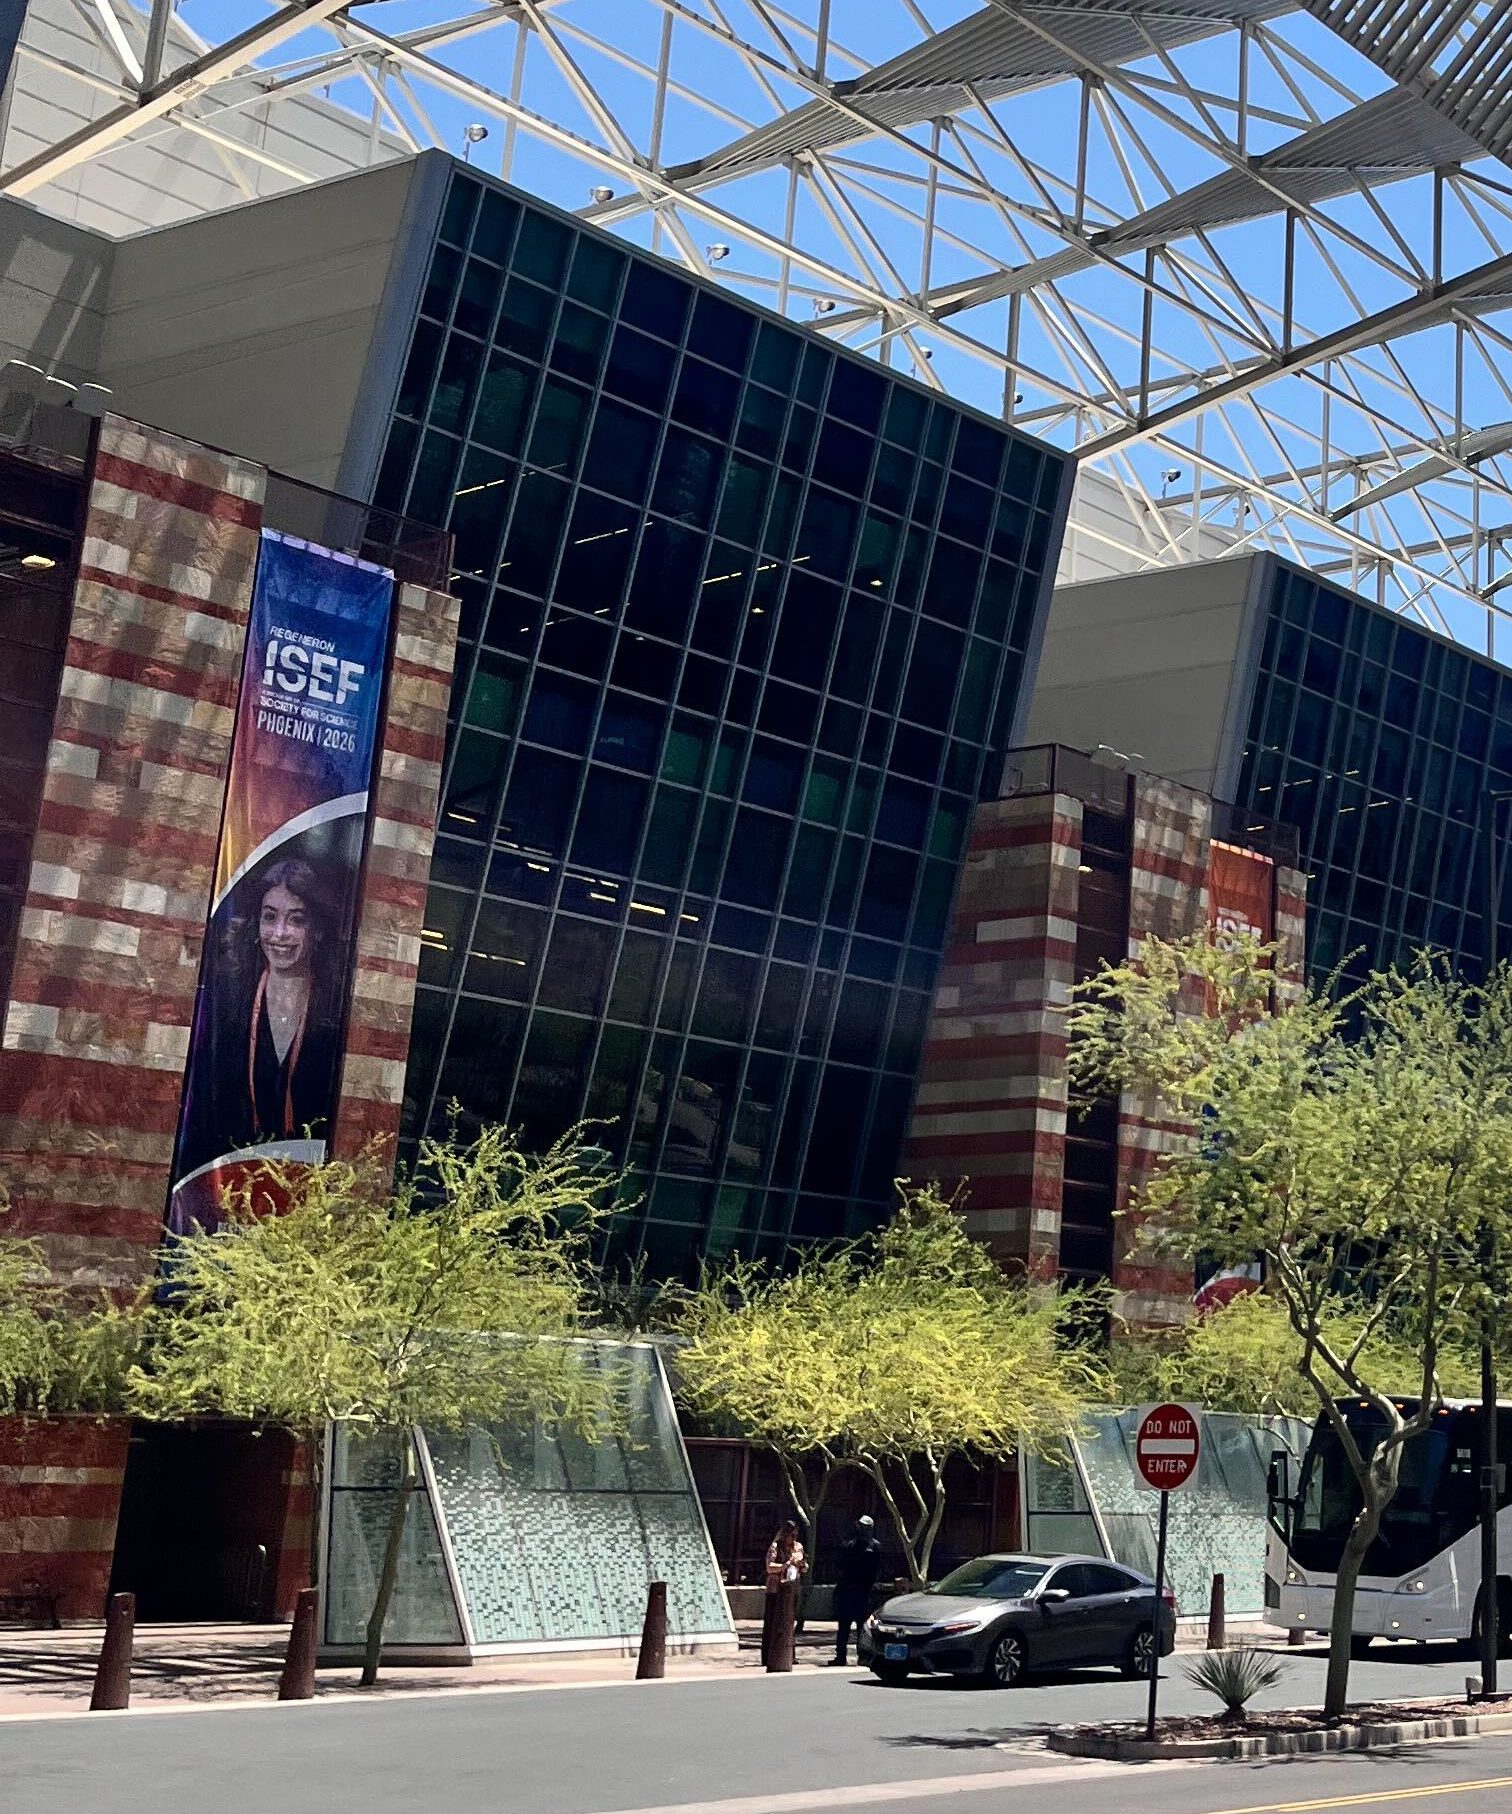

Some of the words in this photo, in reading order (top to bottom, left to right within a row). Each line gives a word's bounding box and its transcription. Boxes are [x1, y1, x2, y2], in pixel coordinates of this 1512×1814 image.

[269, 625, 336, 653] REGENERON
[262, 640, 365, 705] ISEF
[260, 696, 299, 715] SOCIETY
[300, 707, 319, 720] FOR
[257, 710, 315, 744] PHOENIX
[323, 728, 356, 752] 2026
[1145, 1420, 1163, 1434] DO
[1169, 1420, 1192, 1434] NOT
[1147, 1459, 1188, 1474] ENTER
